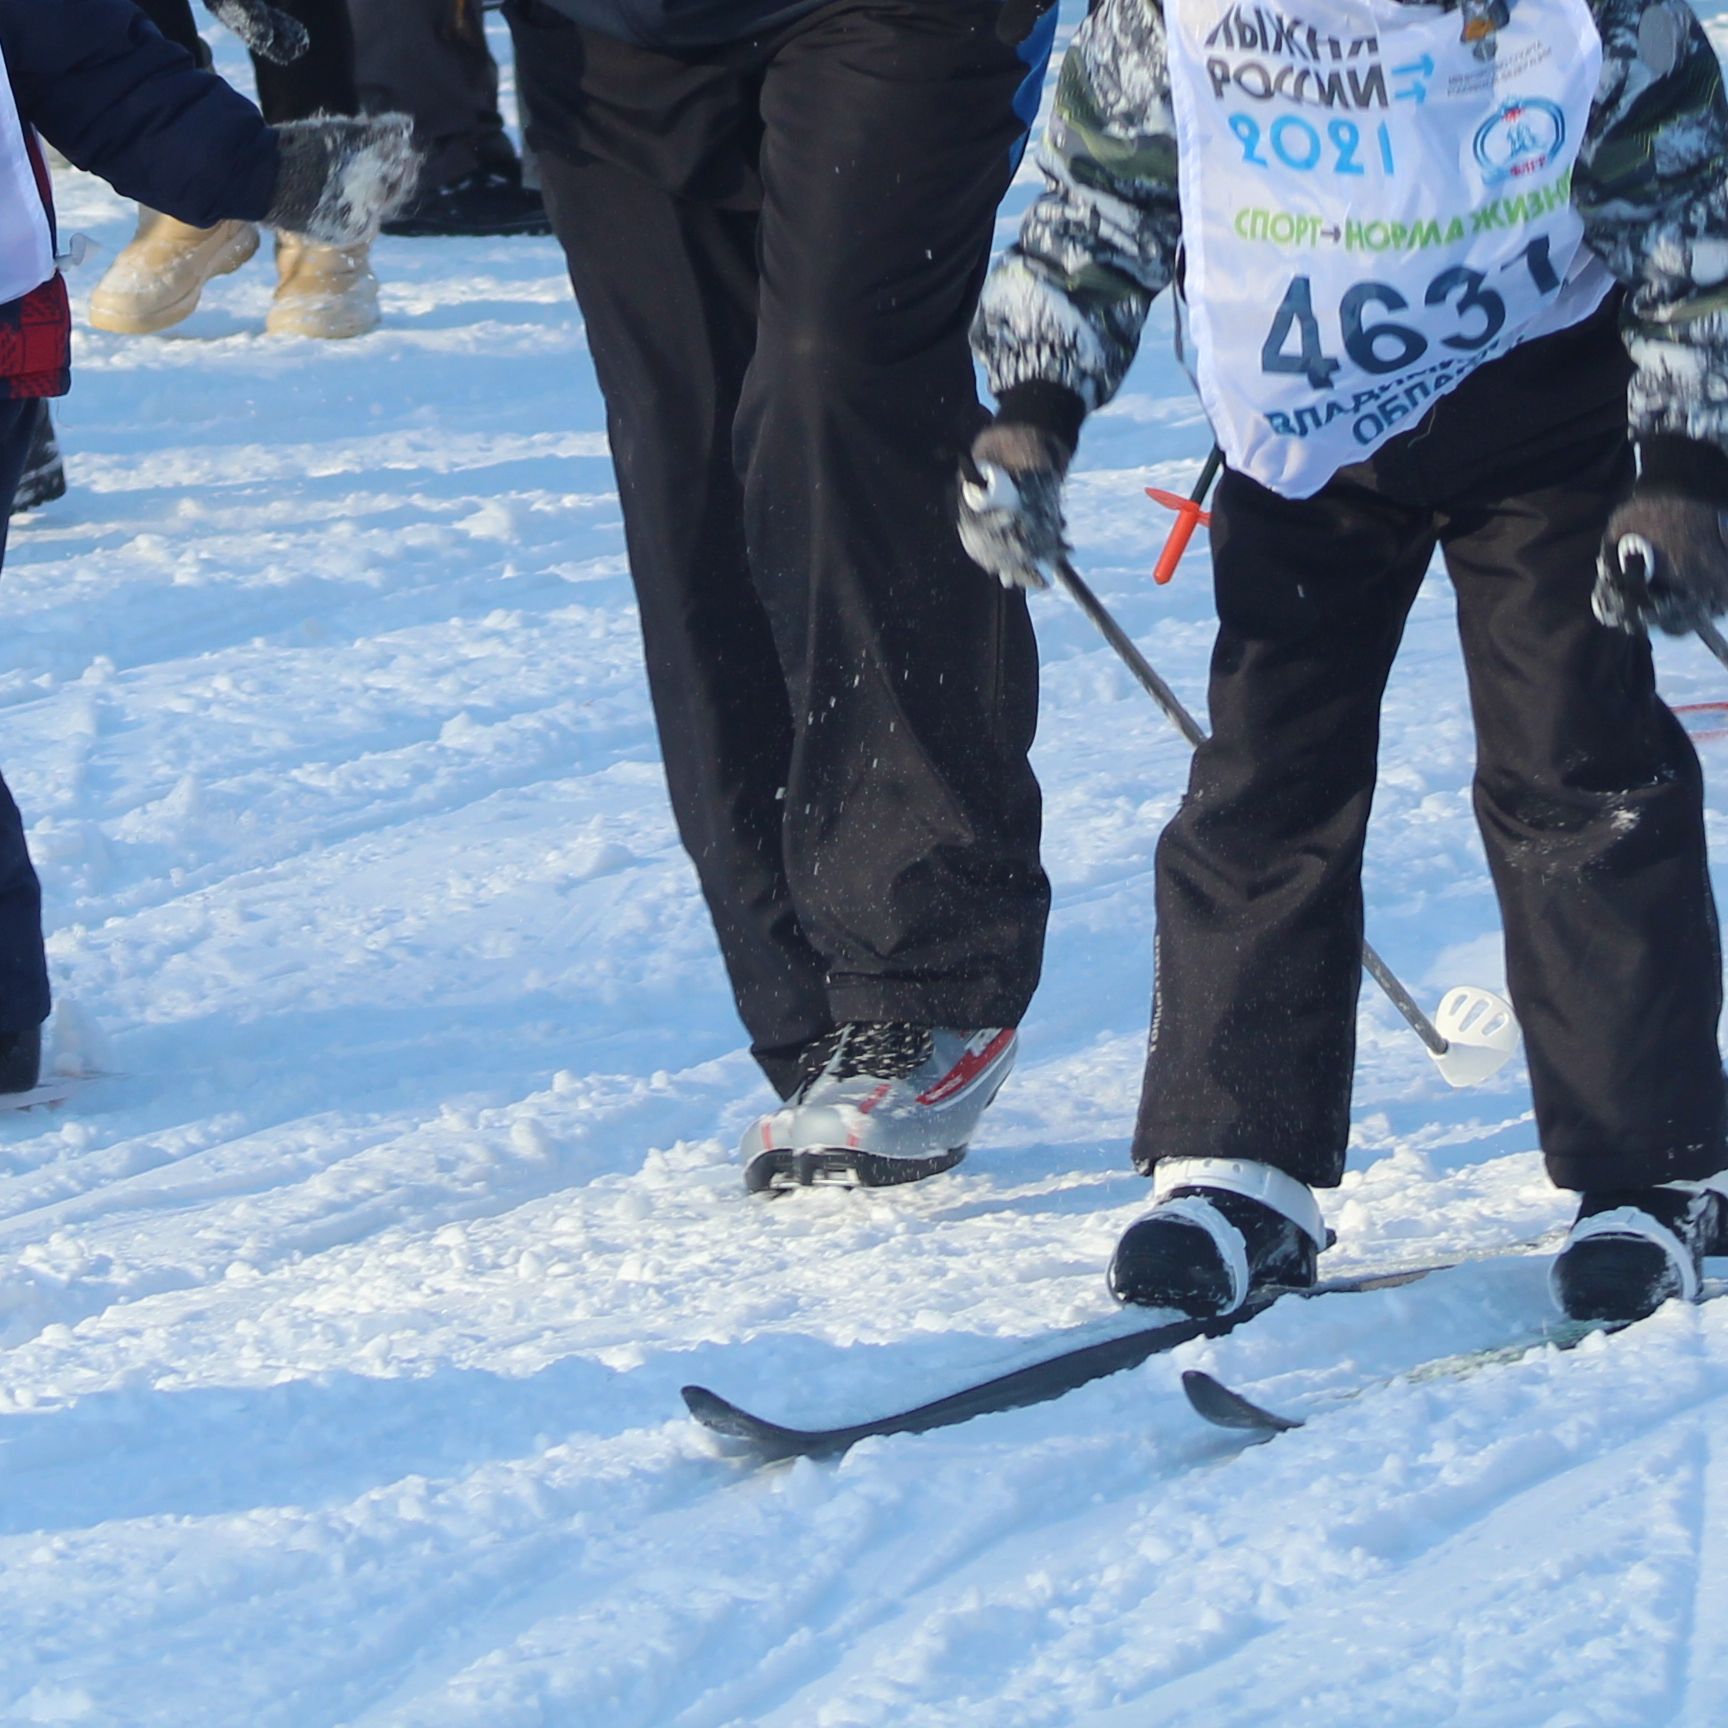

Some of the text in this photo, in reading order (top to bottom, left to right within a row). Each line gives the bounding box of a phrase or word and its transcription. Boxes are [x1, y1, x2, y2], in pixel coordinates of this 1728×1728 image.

[1227, 112, 1395, 176] 2021
[1234, 208, 1322, 249] СПОРТ
[1344, 213, 1465, 252] НОРМА
